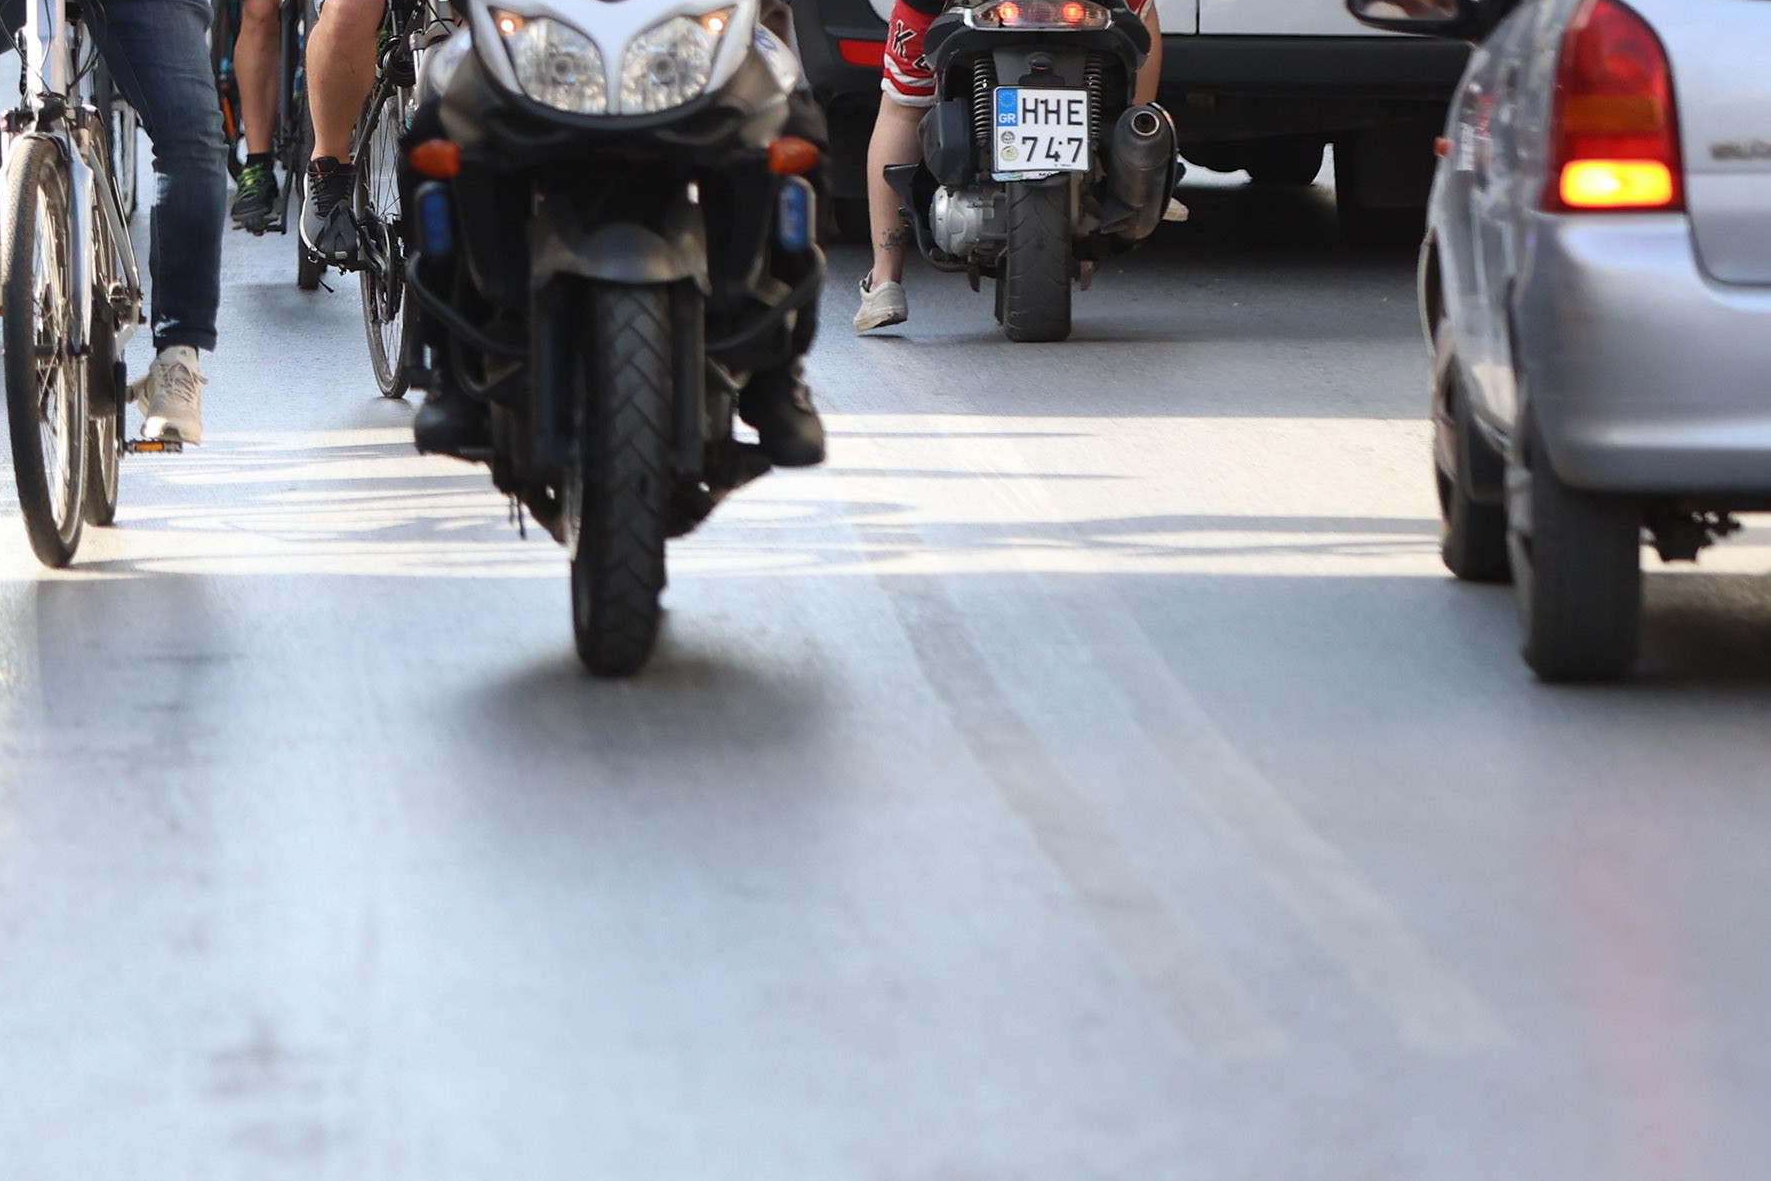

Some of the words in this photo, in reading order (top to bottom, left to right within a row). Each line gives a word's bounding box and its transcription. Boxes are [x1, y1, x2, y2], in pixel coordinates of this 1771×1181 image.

[998, 113, 1017, 124] GR
[1022, 97, 1084, 126] HHE
[1022, 136, 1084, 163] 747
